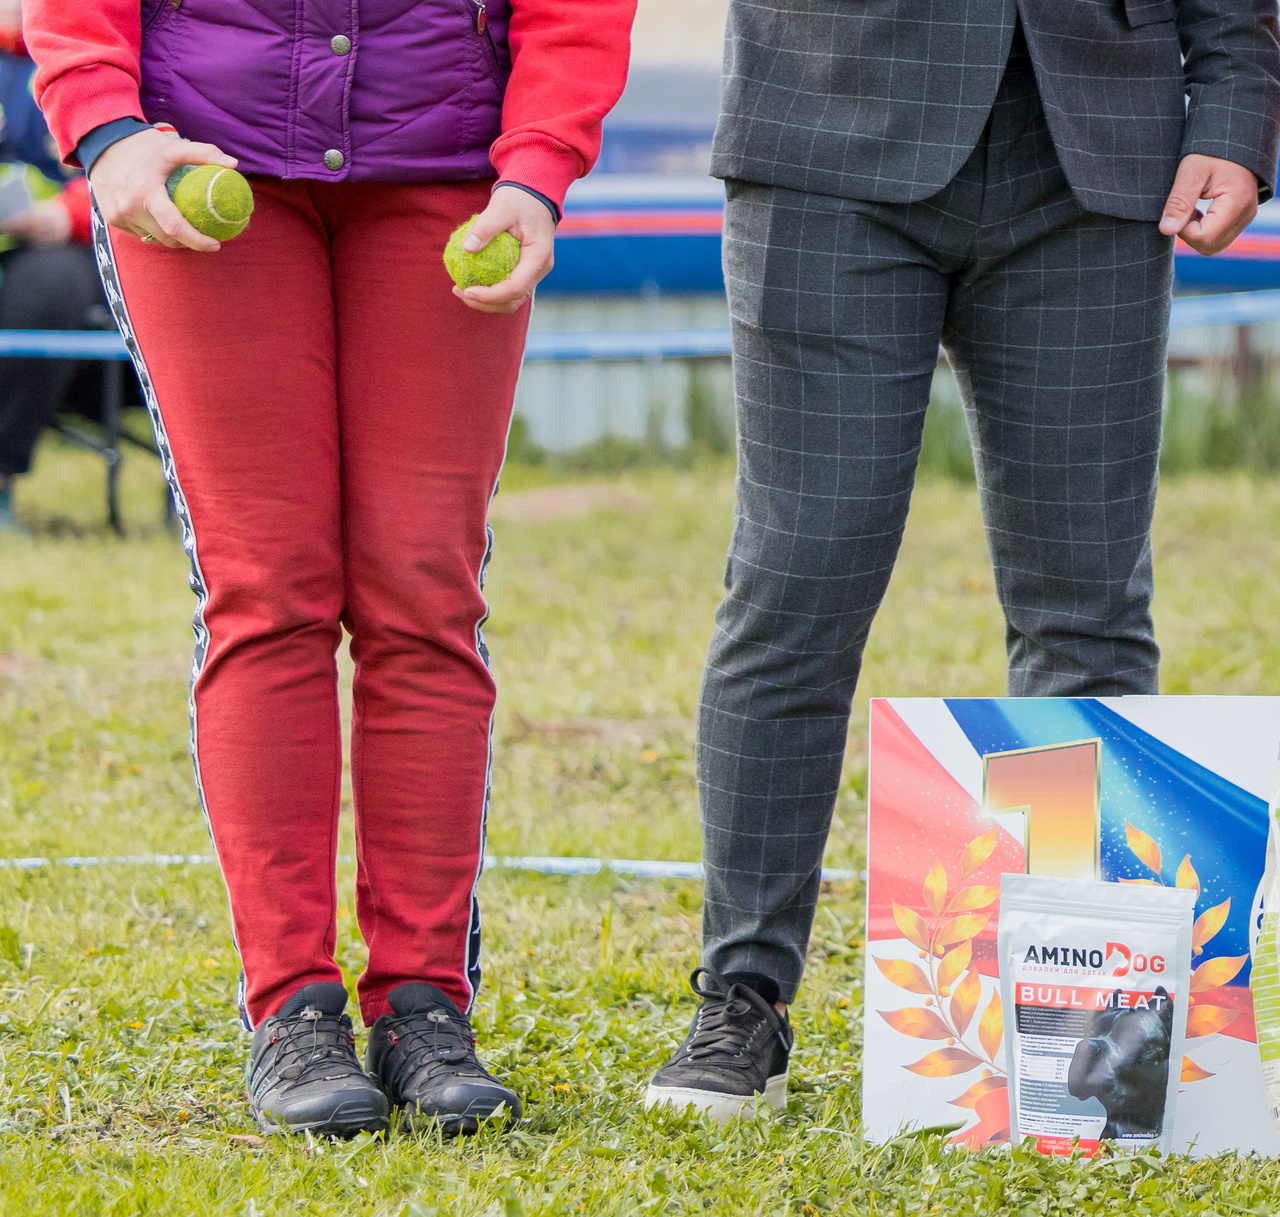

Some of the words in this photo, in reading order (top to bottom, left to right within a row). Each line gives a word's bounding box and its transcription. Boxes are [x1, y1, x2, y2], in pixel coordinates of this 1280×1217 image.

[983, 737, 1102, 882] 1
[1022, 965, 1060, 974] ДОБАВКИ
[1063, 967, 1079, 975] ДЛЯ
[1020, 986, 1083, 1006] BULL
[1095, 991, 1167, 1011] MEAT
